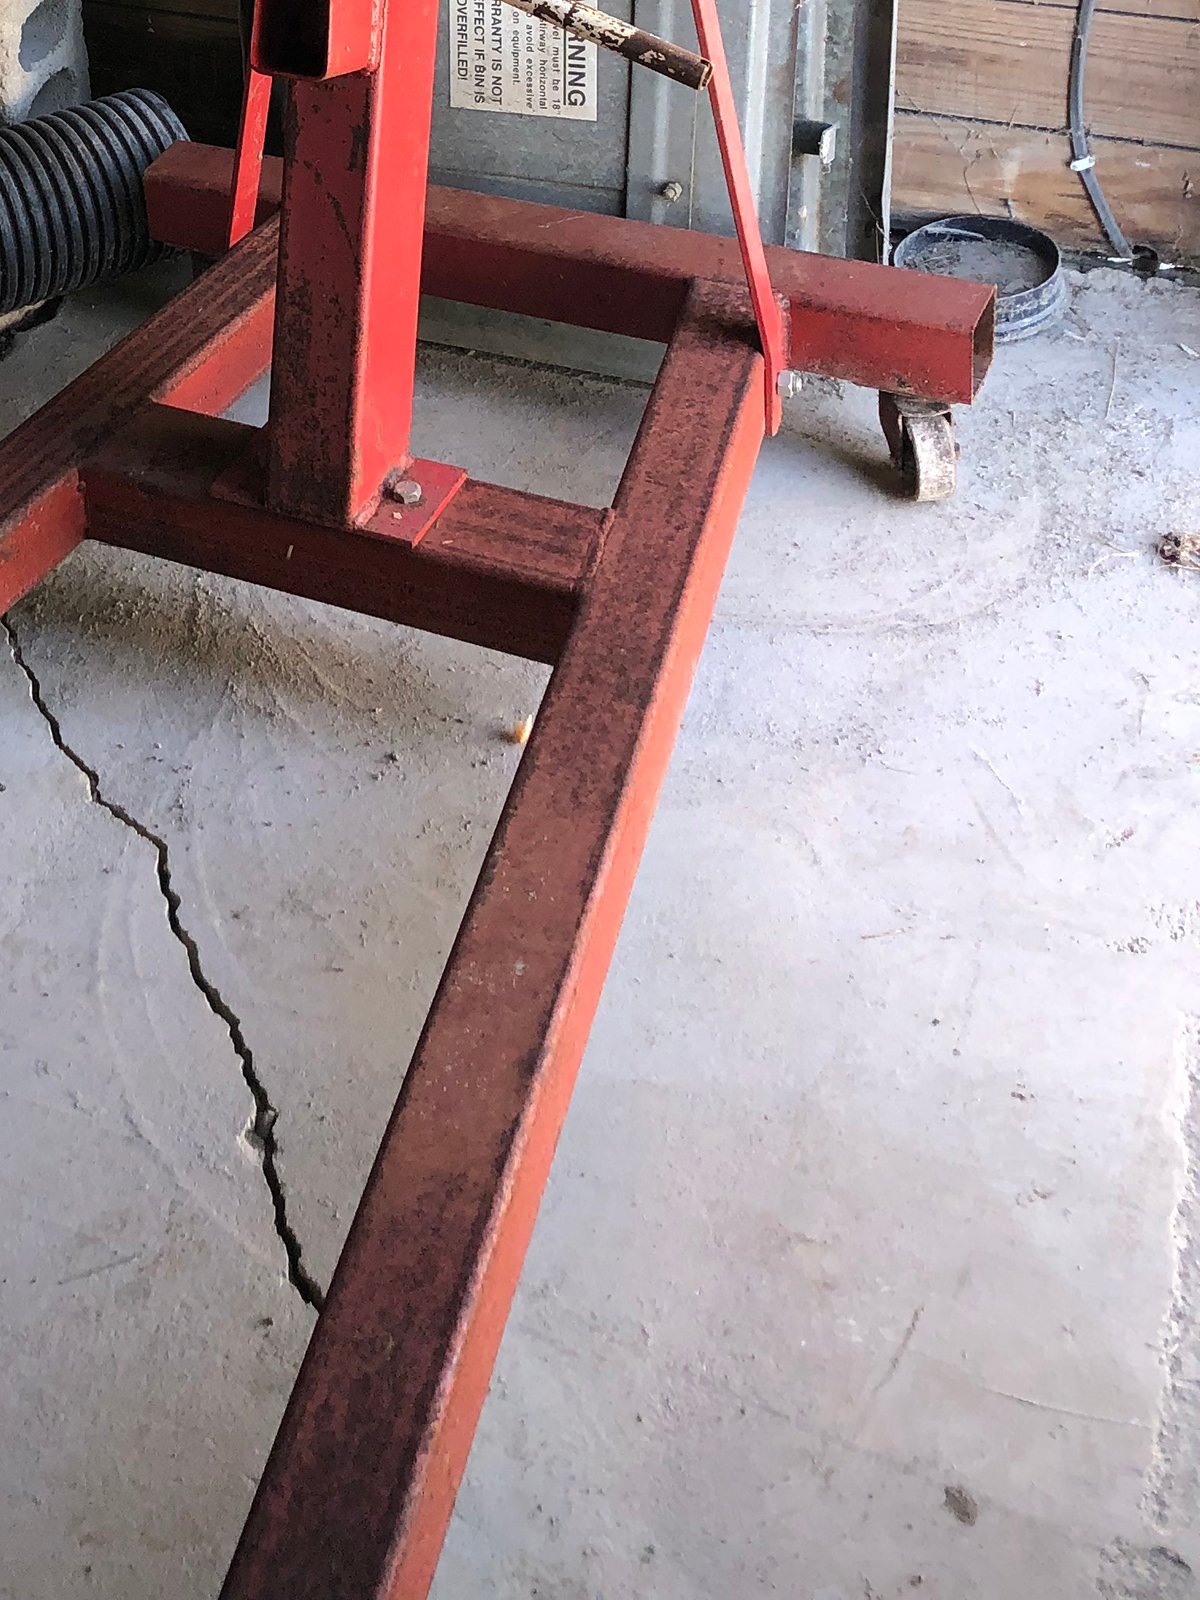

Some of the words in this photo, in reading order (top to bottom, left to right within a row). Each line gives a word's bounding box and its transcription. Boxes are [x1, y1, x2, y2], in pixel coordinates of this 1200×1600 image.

[513, 12, 520, 24] on
[526, 25, 534, 52] avoid
[474, 49, 484, 60] IF
[492, 59, 502, 71] IS
[511, 30, 520, 85] equipment.
[475, 65, 484, 87] BIN
[526, 58, 534, 108] excessive
[540, 60, 548, 109] horizontal
[553, 79, 560, 91] be
[475, 92, 484, 103] IS
[492, 76, 502, 105] NOT
